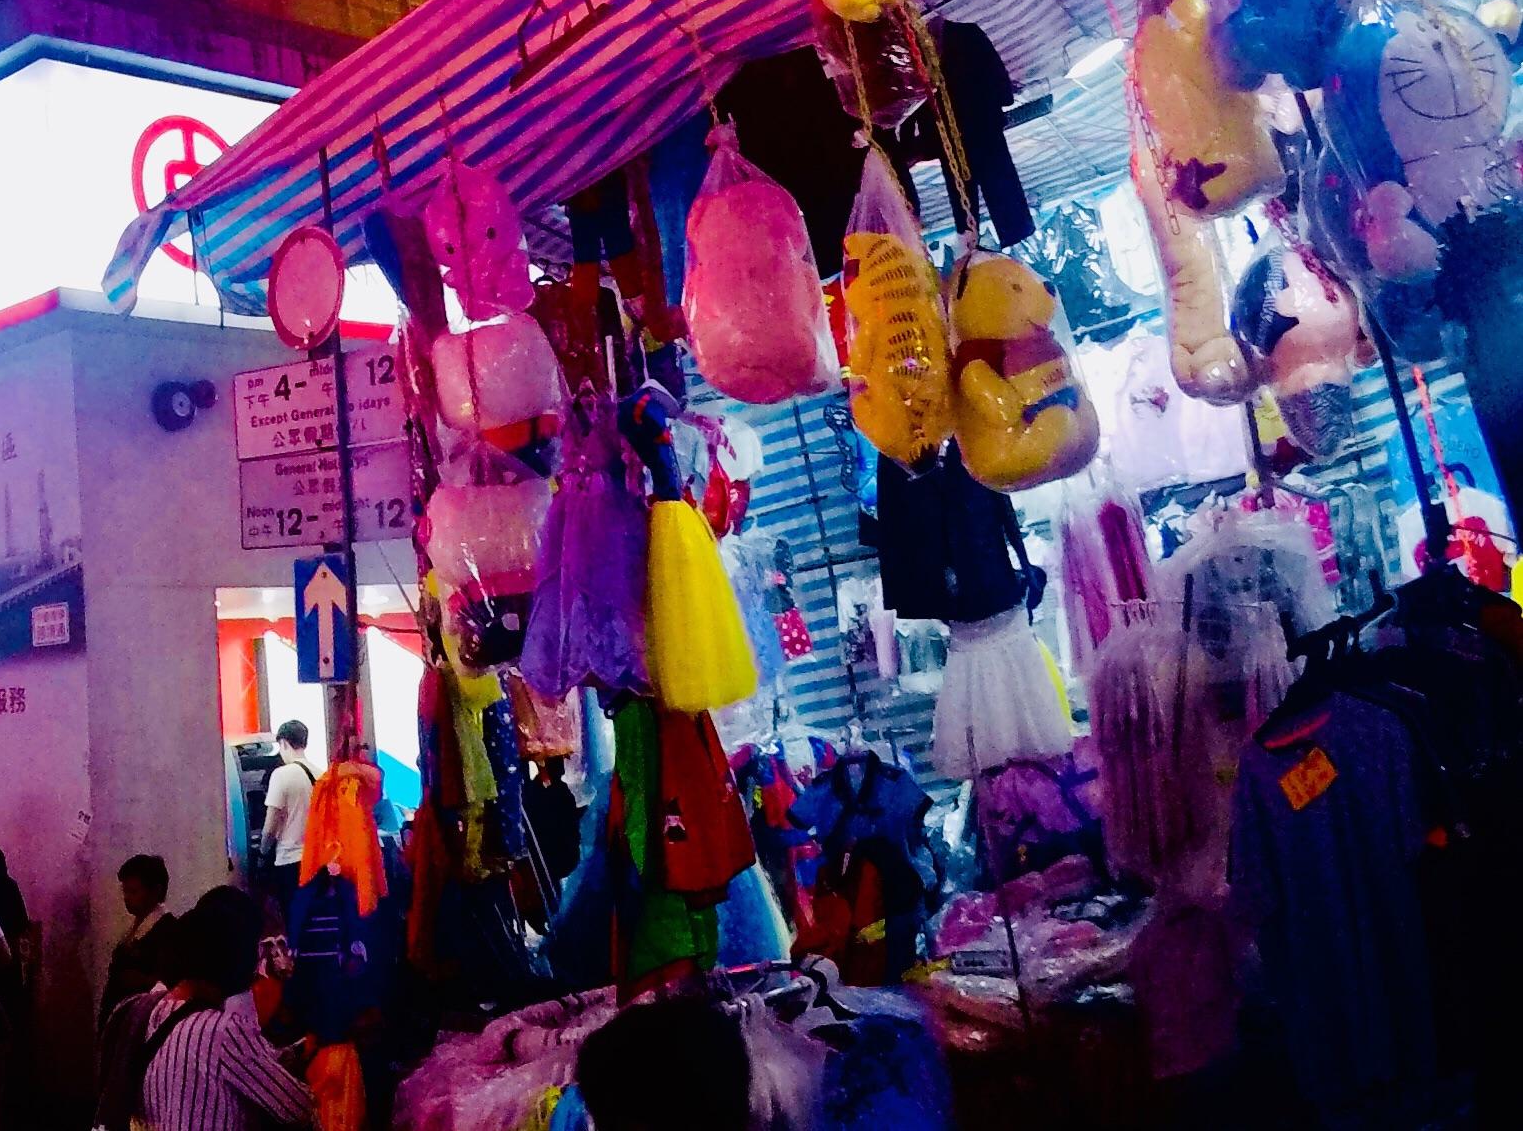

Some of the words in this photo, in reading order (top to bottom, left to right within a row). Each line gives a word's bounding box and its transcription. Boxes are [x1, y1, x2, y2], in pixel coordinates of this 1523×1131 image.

[366, 355, 396, 386] 12
[250, 412, 288, 428] Except
[291, 406, 335, 421] General
[247, 507, 275, 518] Noon
[375, 497, 406, 529] 12
